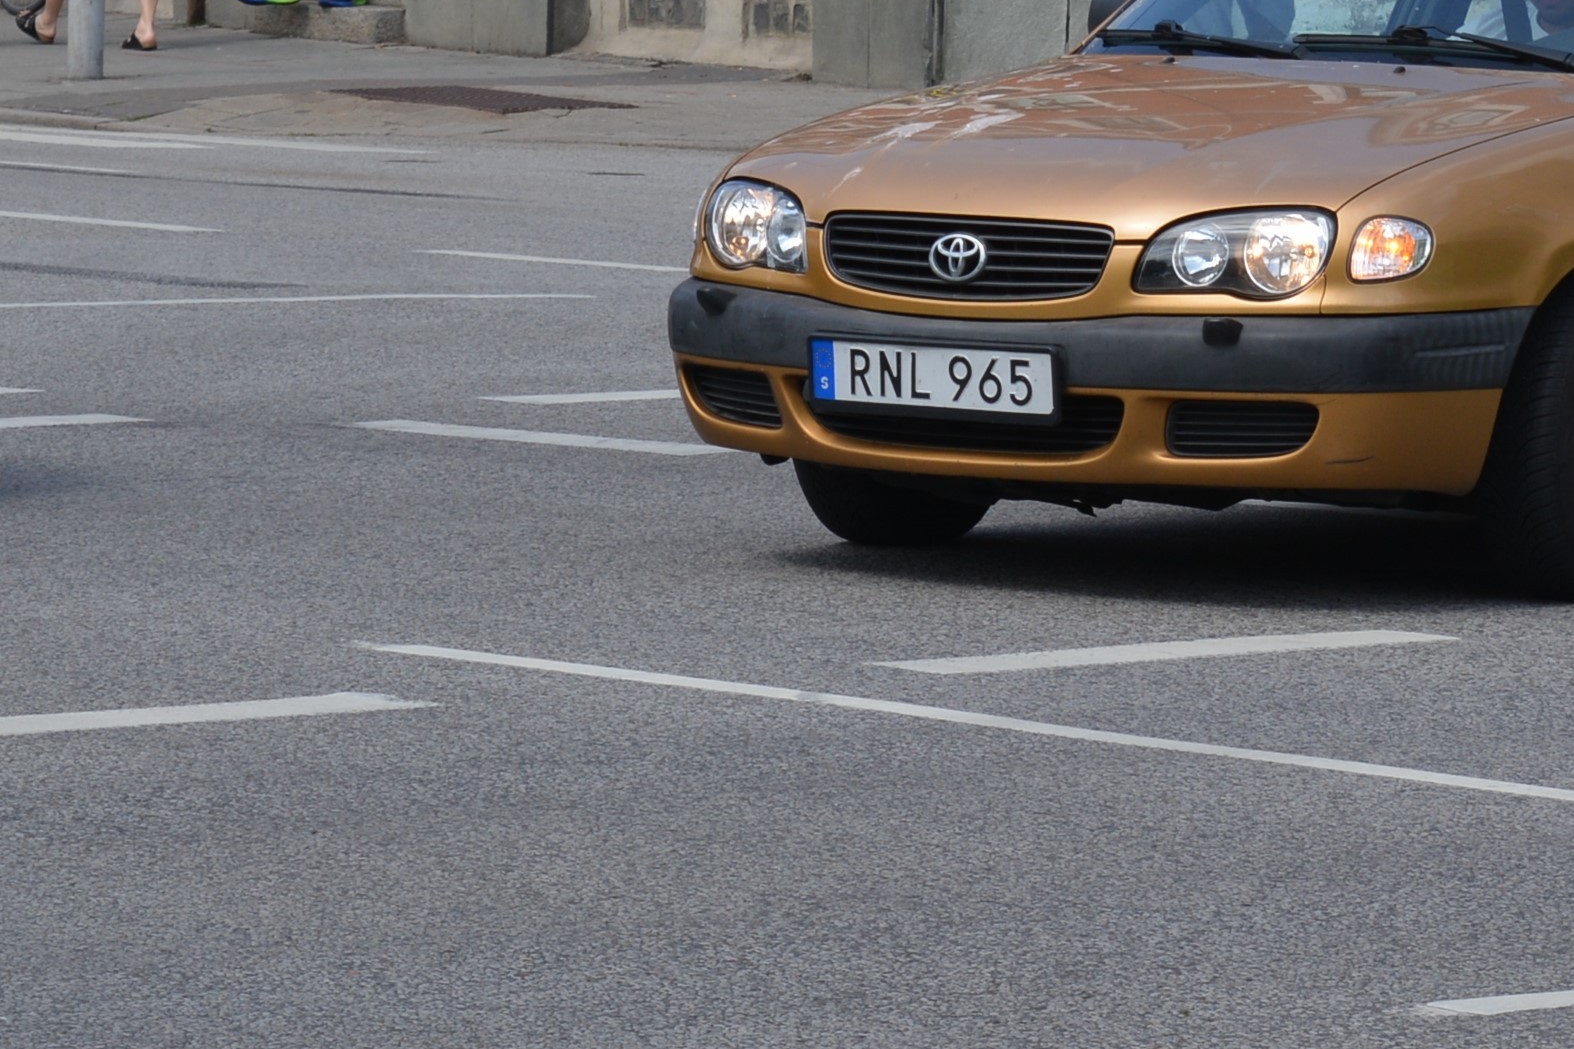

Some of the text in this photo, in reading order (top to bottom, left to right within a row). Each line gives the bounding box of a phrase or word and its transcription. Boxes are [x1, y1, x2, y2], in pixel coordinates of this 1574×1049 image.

[820, 376, 829, 390] S
[849, 347, 1033, 406] RNL 965
